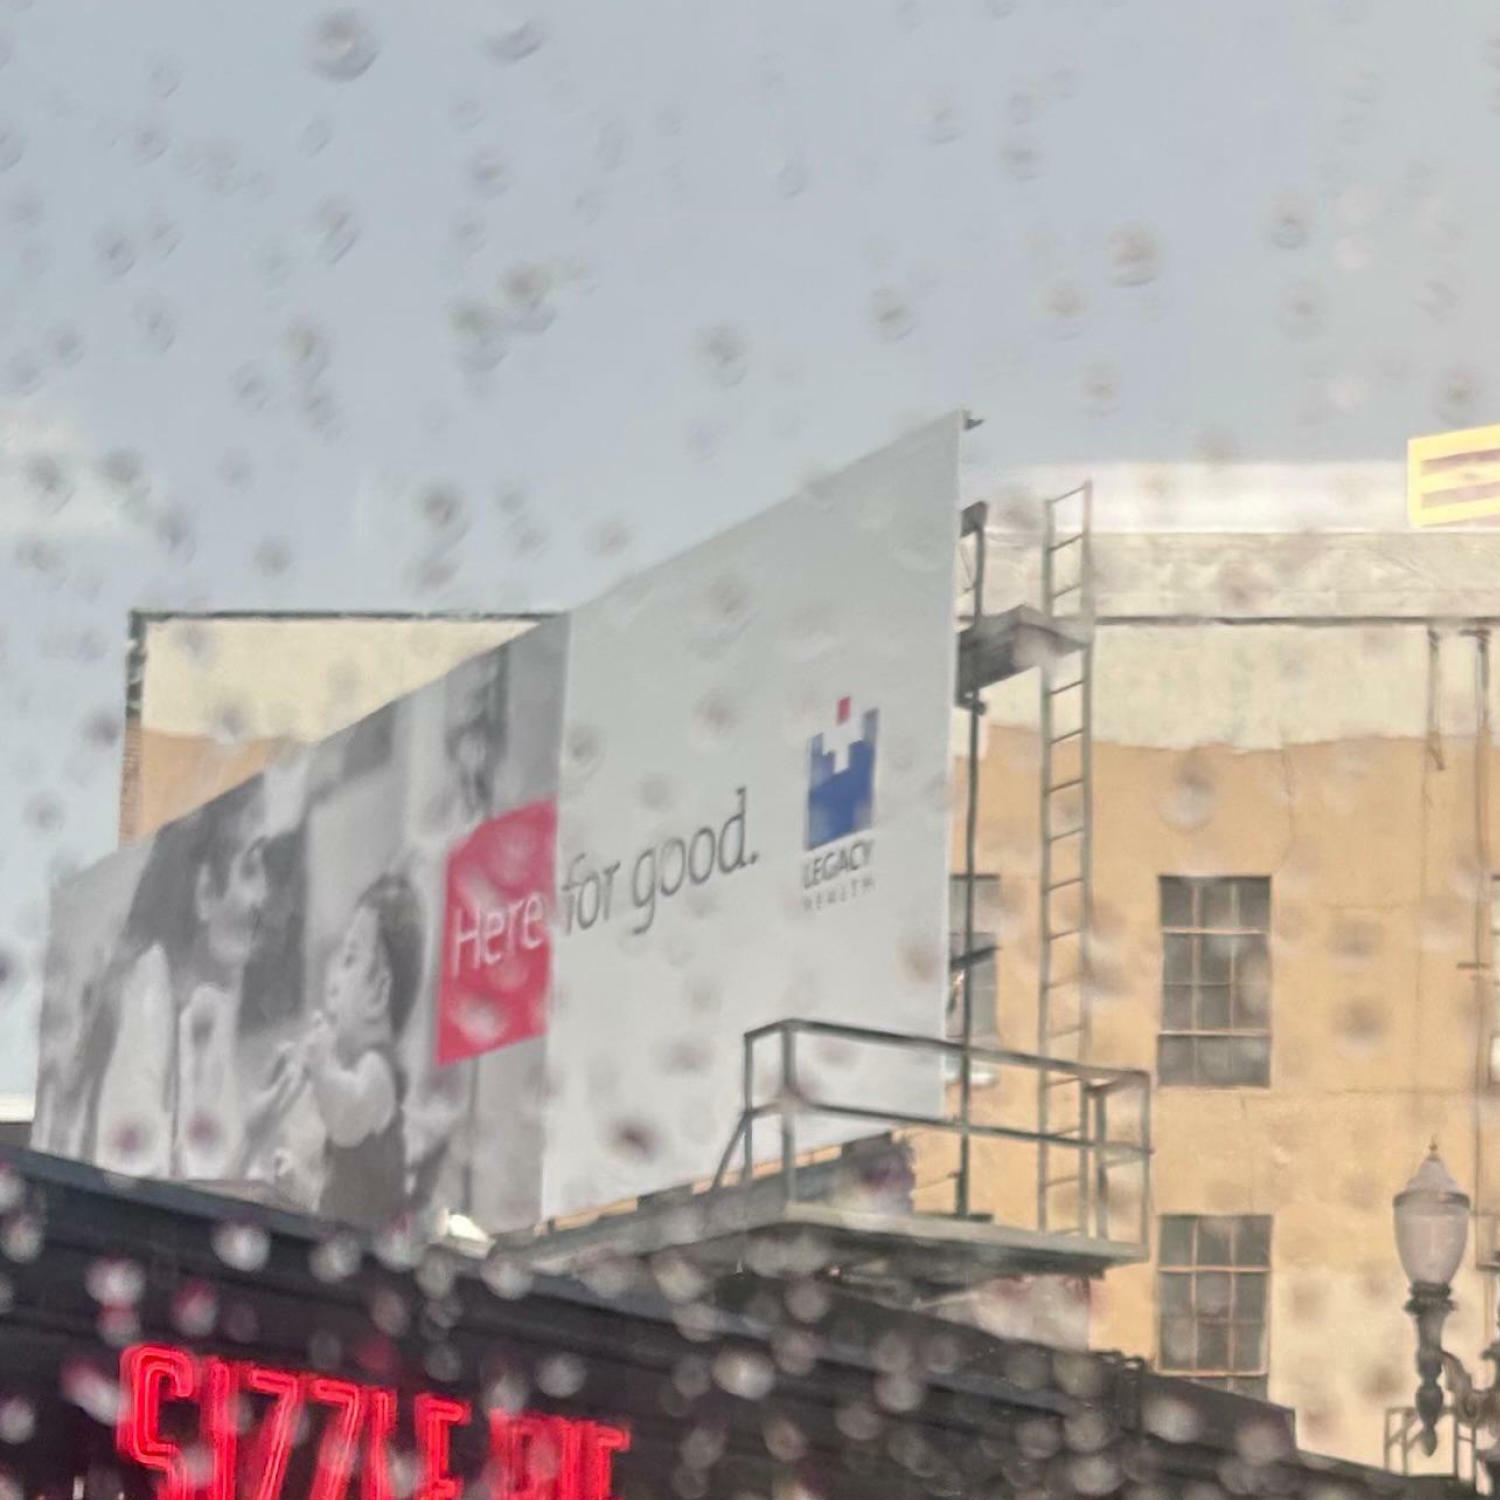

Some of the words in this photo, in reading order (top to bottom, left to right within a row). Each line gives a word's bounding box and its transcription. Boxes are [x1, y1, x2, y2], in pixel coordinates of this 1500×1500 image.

[452, 891, 545, 980] Here
[562, 853, 621, 935] for
[631, 786, 759, 936] good.
[803, 839, 876, 890] LEGACY
